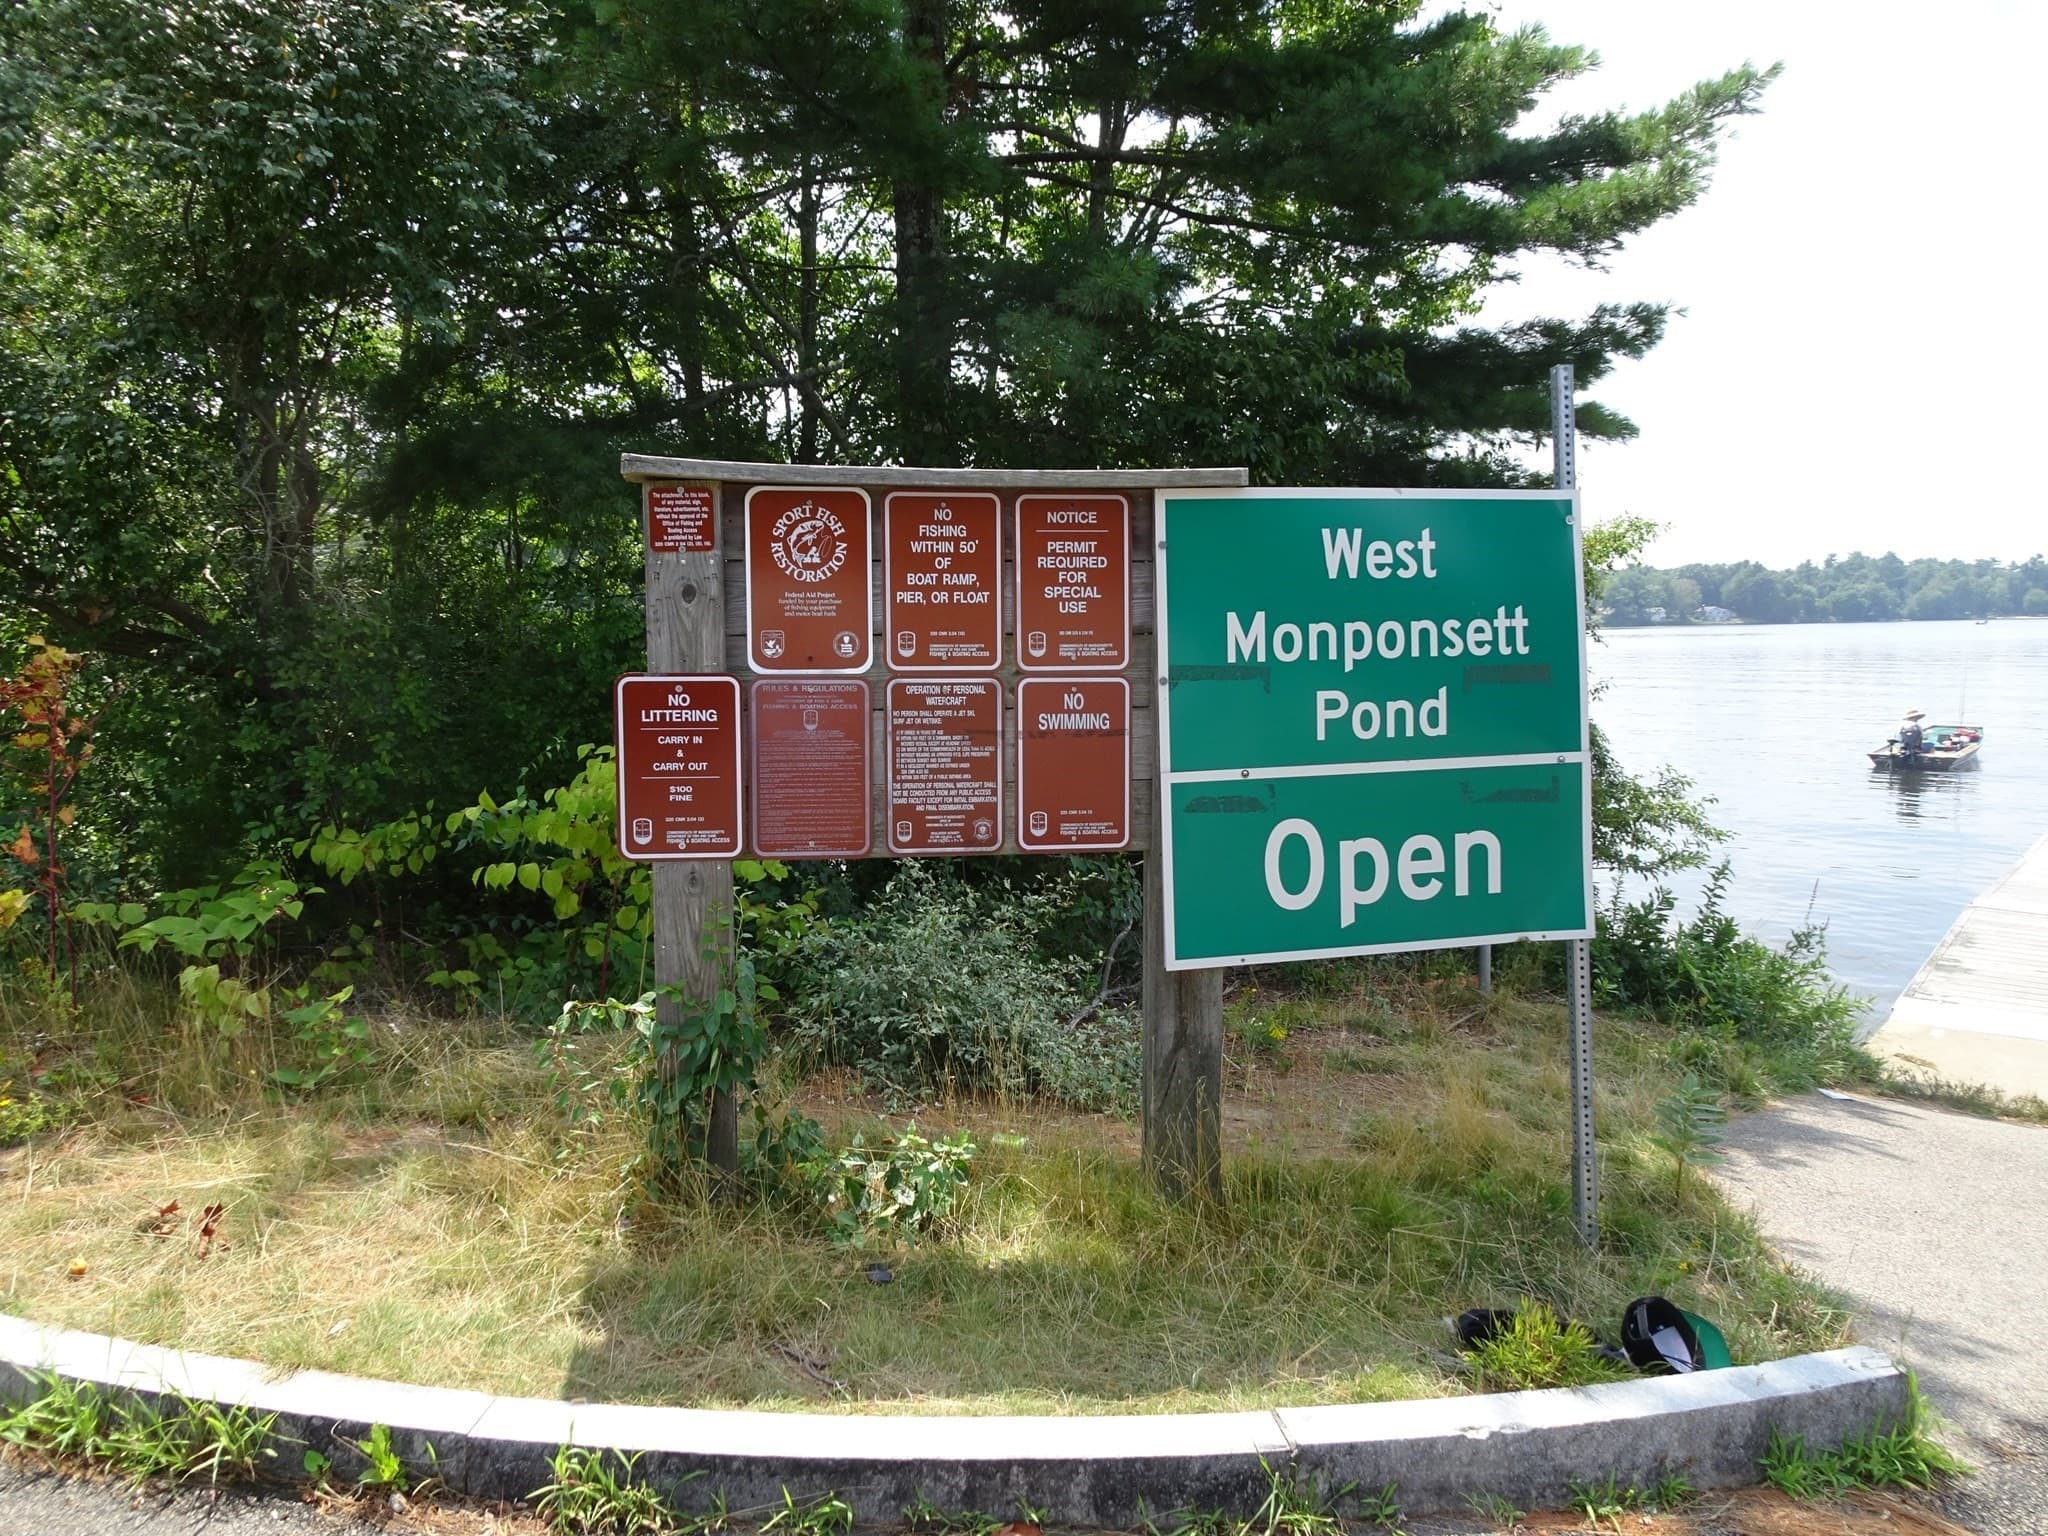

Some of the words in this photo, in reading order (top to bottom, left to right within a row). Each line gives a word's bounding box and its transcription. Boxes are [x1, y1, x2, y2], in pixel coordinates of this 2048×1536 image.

[934, 508, 952, 520] NO
[1047, 512, 1097, 523] NOTICE
[772, 505, 812, 537] SPORT
[816, 507, 845, 537] FISH
[919, 525, 967, 537] FISHING
[911, 541, 954, 553] WITHIN
[959, 539, 979, 553] 50'
[1047, 542, 1097, 553] PERMIT
[1321, 527, 1437, 579] West
[771, 542, 848, 582] RESTORATION
[934, 557, 952, 569] OF
[1037, 556, 1107, 568] REQUIRED
[907, 573, 938, 585] BOAT
[942, 573, 979, 588] RAMP,
[1058, 571, 1087, 583] FOR
[896, 592, 926, 605] PIER,
[931, 591, 949, 603] OR
[953, 592, 990, 603] FLOAT
[1044, 586, 1102, 598] SPECIAL
[1059, 601, 1087, 613] USE
[1226, 605, 1530, 673] Monponsett
[906, 685, 940, 694] OPERATION
[942, 685, 951, 694] OF
[953, 684, 986, 694] PERSONAL
[667, 694, 690, 707] NO
[926, 696, 966, 705] WATERCRAFT
[1064, 693, 1084, 710] NO
[641, 709, 718, 722] LITTERING
[1316, 686, 1448, 741] Pond
[1038, 713, 1110, 730] SWIMMING
[658, 736, 690, 744] CARRY
[693, 736, 702, 744] IN
[677, 749, 684, 757] &
[653, 762, 685, 771] CARRY
[688, 762, 708, 770] OUT
[1264, 818, 1502, 928] Open
